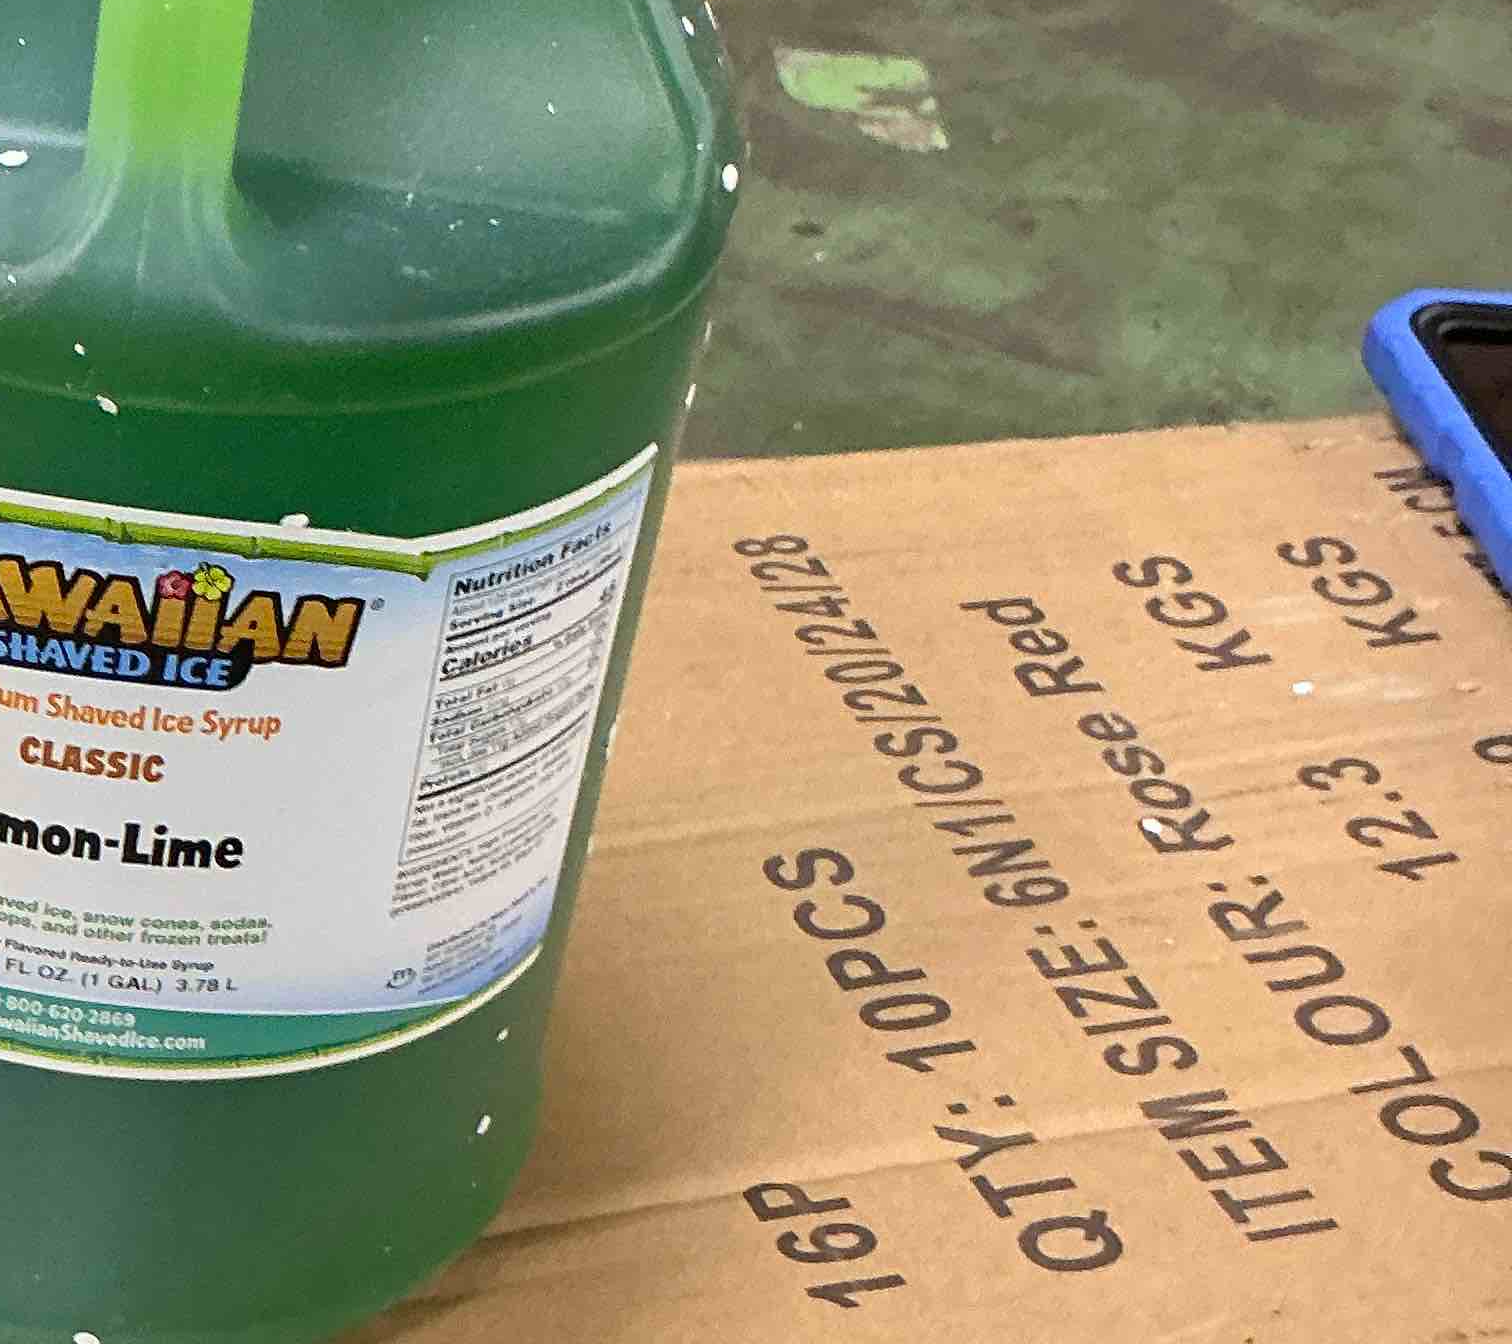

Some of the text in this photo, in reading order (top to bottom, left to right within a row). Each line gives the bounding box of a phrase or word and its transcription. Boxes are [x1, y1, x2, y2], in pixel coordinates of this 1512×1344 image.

[453, 553, 555, 597] Nutrition
[559, 521, 612, 560] Facts
[1276, 534, 1441, 648] KGS
[1111, 553, 1273, 673] KGS
[160, 655, 232, 687] ICE
[441, 635, 532, 675] Calories
[45, 693, 146, 733] Shaved
[151, 708, 194, 735] Ice
[199, 710, 283, 743] Syrup
[19, 735, 165, 783] CLASSIC
[1297, 756, 1459, 881] 12.3
[42, 920, 78, 937] and
[83, 926, 135, 943] other
[140, 930, 201, 945] frozen
[83, 911, 134, 927] snow
[960, 596, 1512, 1202] COLOUR: Rose Red
[4, 937, 67, 960] Flavored
[5, 957, 32, 975] FL
[107, 974, 162, 994] GAL)
[175, 978, 220, 993] 3.78
[225, 978, 239, 992] L
[1025, 918, 1199, 1077] SIZE:
[762, 847, 1125, 1273] QTY: 10PCS
[1141, 1088, 1339, 1242] ITEM
[743, 1181, 907, 1309] 16P
